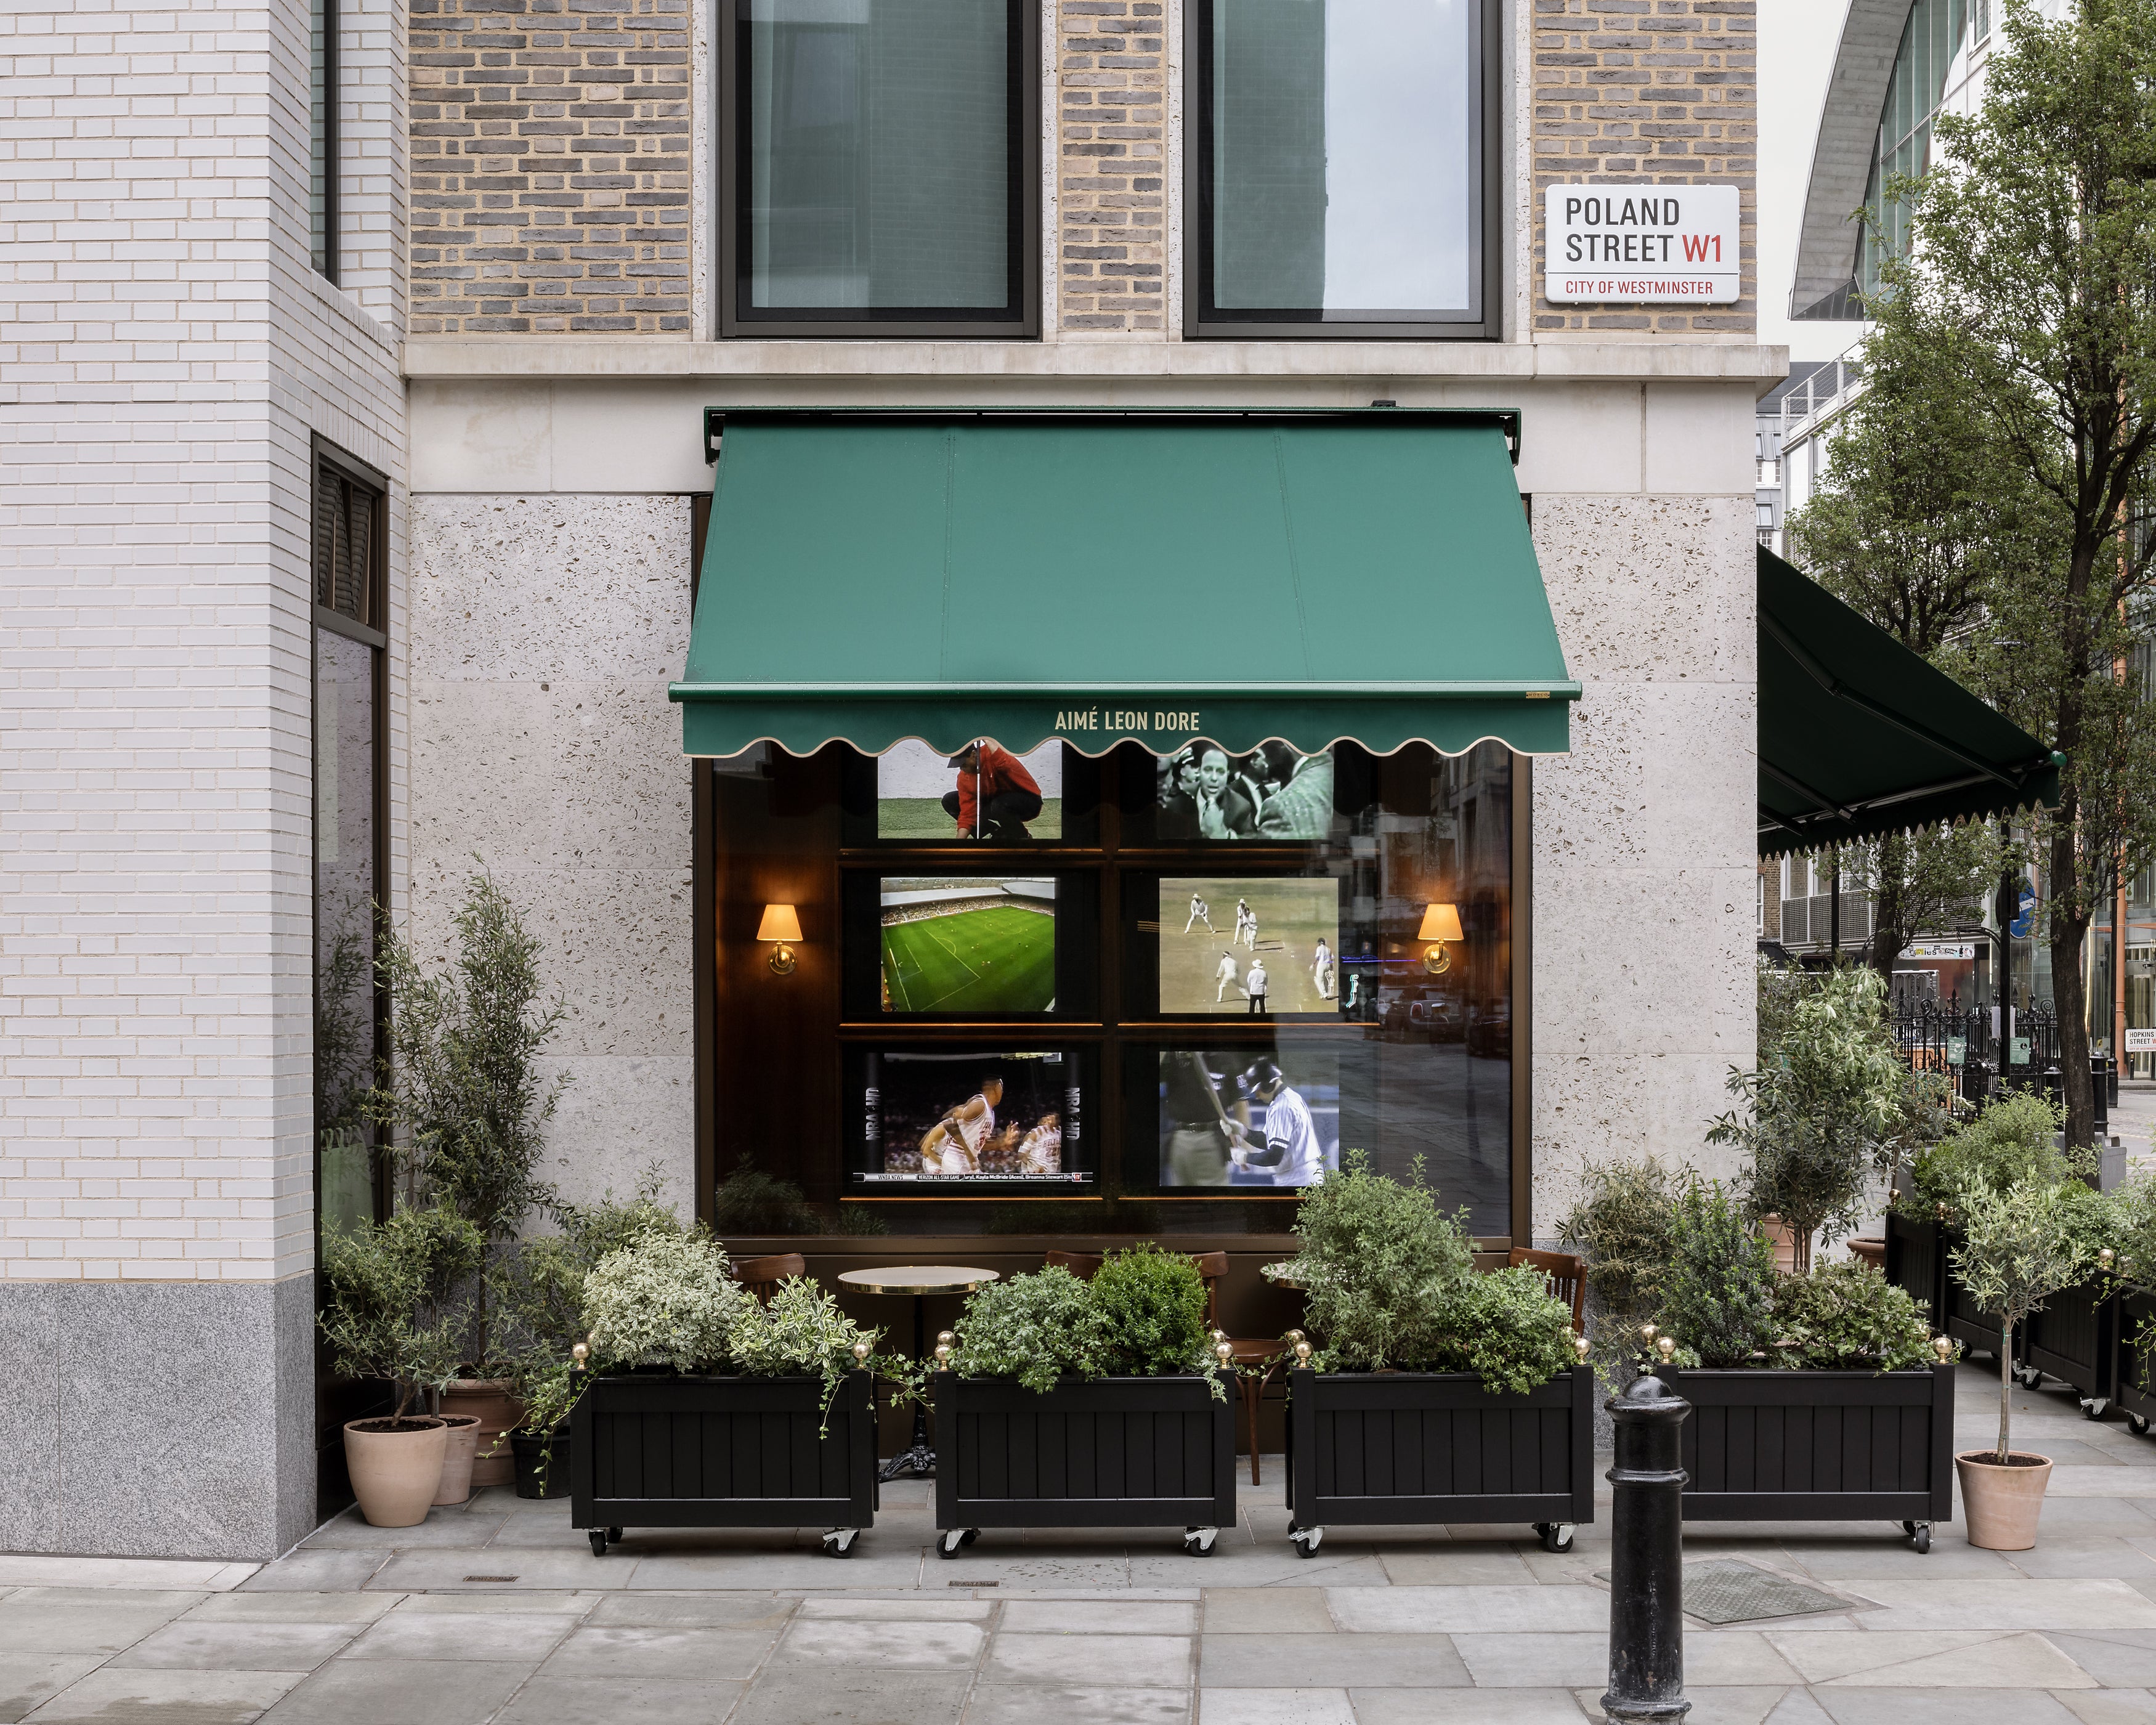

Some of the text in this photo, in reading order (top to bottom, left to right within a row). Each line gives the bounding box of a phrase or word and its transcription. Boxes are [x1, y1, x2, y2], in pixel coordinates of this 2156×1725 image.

[1566, 197, 1680, 226] POLAND
[1565, 233, 1721, 262] STREET W1
[1565, 280, 1713, 294] CITY OF WESTMINSTER
[1055, 706, 1199, 731] AIMÉ LEON DORE
[865, 1087, 881, 1140] NBA HD
[1064, 1087, 1080, 1140] NBA HD
